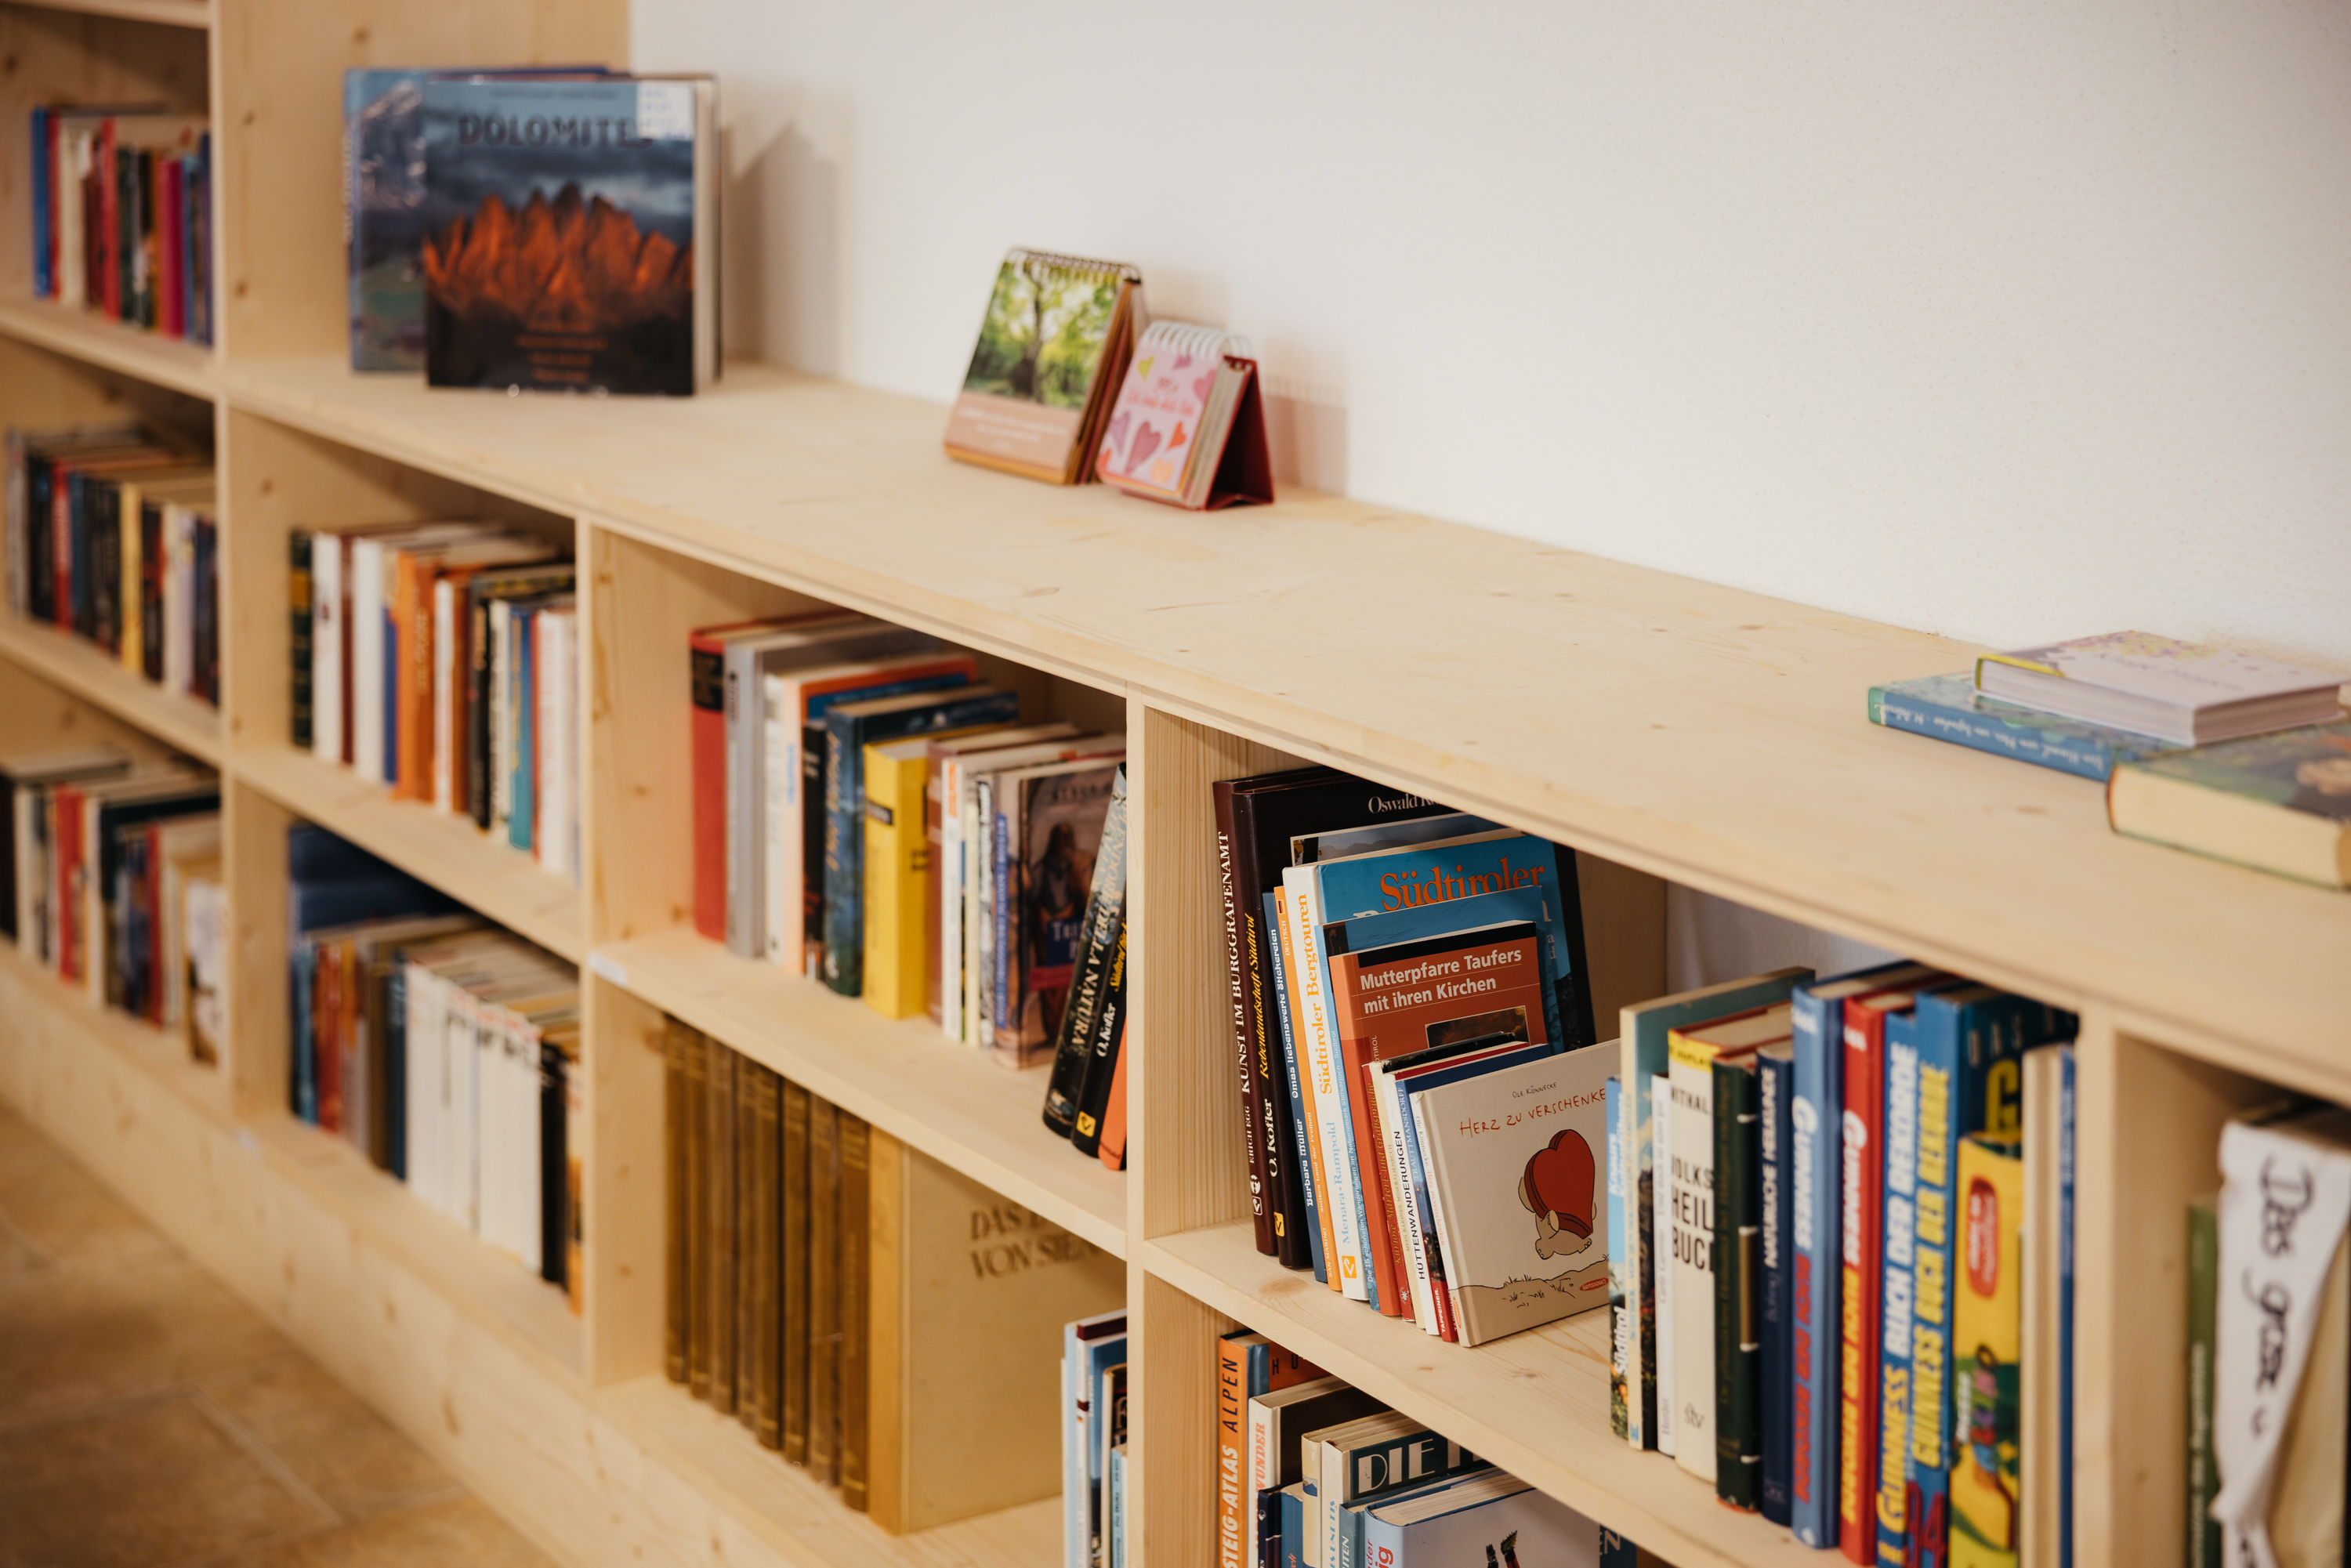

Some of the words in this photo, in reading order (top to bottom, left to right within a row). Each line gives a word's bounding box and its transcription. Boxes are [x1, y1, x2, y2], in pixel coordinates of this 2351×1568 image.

[1368, 793, 1418, 813] Oswald
[1380, 856, 1545, 911] Südtiroler
[1218, 831, 1242, 999] BURGGRAFENAMT
[1244, 913, 1259, 971] Südtirol
[1281, 920, 1291, 957] DEUTSCH
[1270, 929, 1284, 990] Stickereien
[1298, 893, 1320, 998] Bergtouren
[1360, 958, 1460, 990] Mutterpfarre
[1463, 949, 1522, 971] Taufers
[1071, 968, 1099, 1045] NATURA
[1234, 1002, 1244, 1027] IM
[1364, 997, 1389, 1014] mit
[1393, 989, 1433, 1009] ihren
[1436, 977, 1497, 1000] Kirchen
[1252, 969, 1270, 1080] Rebenlandschaft
[1277, 991, 1295, 1063] liebenswerte
[1311, 1003, 1332, 1095] Südtiroler
[1331, 1030, 1339, 1059] Südtirol
[1237, 1031, 1251, 1094] KUNST
[1285, 1065, 1299, 1099] Omas
[1337, 1064, 1347, 1106] Stilfserjoch
[1526, 1081, 1557, 1095] KÖNNECKE
[1264, 1099, 1277, 1153] Kofler
[1295, 1118, 1307, 1157] Müller
[1306, 1112, 1315, 1143] Freiheit
[1342, 1106, 1355, 1153] Nationalpark
[1369, 1081, 1385, 1150] Grabsprüche
[1397, 1087, 1419, 1179] TRAUTTMANSDORFF
[1459, 1117, 1501, 1138] HERZ
[1506, 1112, 1522, 1126] ZU
[1888, 1041, 1919, 1197] REKORDE
[1917, 1059, 1950, 1189] REKORDE
[1269, 1157, 1278, 1177] O.
[1326, 1121, 1343, 1186] Rampold
[1379, 1151, 1388, 1173] und
[1388, 1145, 1401, 1202] MINERALIENBUCH
[1418, 1131, 1429, 1167] Könnecke
[1792, 1095, 1817, 1251] GUINNESS
[1300, 1160, 1314, 1207] Barbara
[1314, 1190, 1324, 1212] antikes
[1352, 1166, 1367, 1218] Wanderungen
[1393, 1132, 1425, 1280] HÜTTENWANDERUNGEN
[1842, 1110, 1867, 1266] GUINNESS
[2259, 1152, 2314, 1258] Das
[1320, 1227, 1330, 1260] MARINO
[1336, 1190, 1351, 1245] Menara
[1358, 1218, 1371, 1257] schönsten
[1397, 1204, 1407, 1233] KLEINES
[1430, 1188, 1436, 1199] zu
[1433, 1200, 1445, 1246] verschenken
[1886, 1194, 1914, 1267] DER
[1915, 1185, 1947, 1247] DER
[1363, 1258, 1371, 1268] 15
[1389, 1223, 1402, 1267] Kuriose
[1581, 1278, 1607, 1291] sanssouci
[1884, 1265, 1913, 1359] BUCH
[1914, 1244, 1946, 1326] BUCH
[1614, 1306, 1627, 1376] Südtirol
[1222, 1357, 1238, 1433] ALPEN
[1911, 1324, 1945, 1468] GUINNESS
[1358, 1438, 1436, 1494] DIE
[1876, 1362, 1910, 1534] GUINNESS
[1221, 1444, 1238, 1568] STEIG-ATLAS
